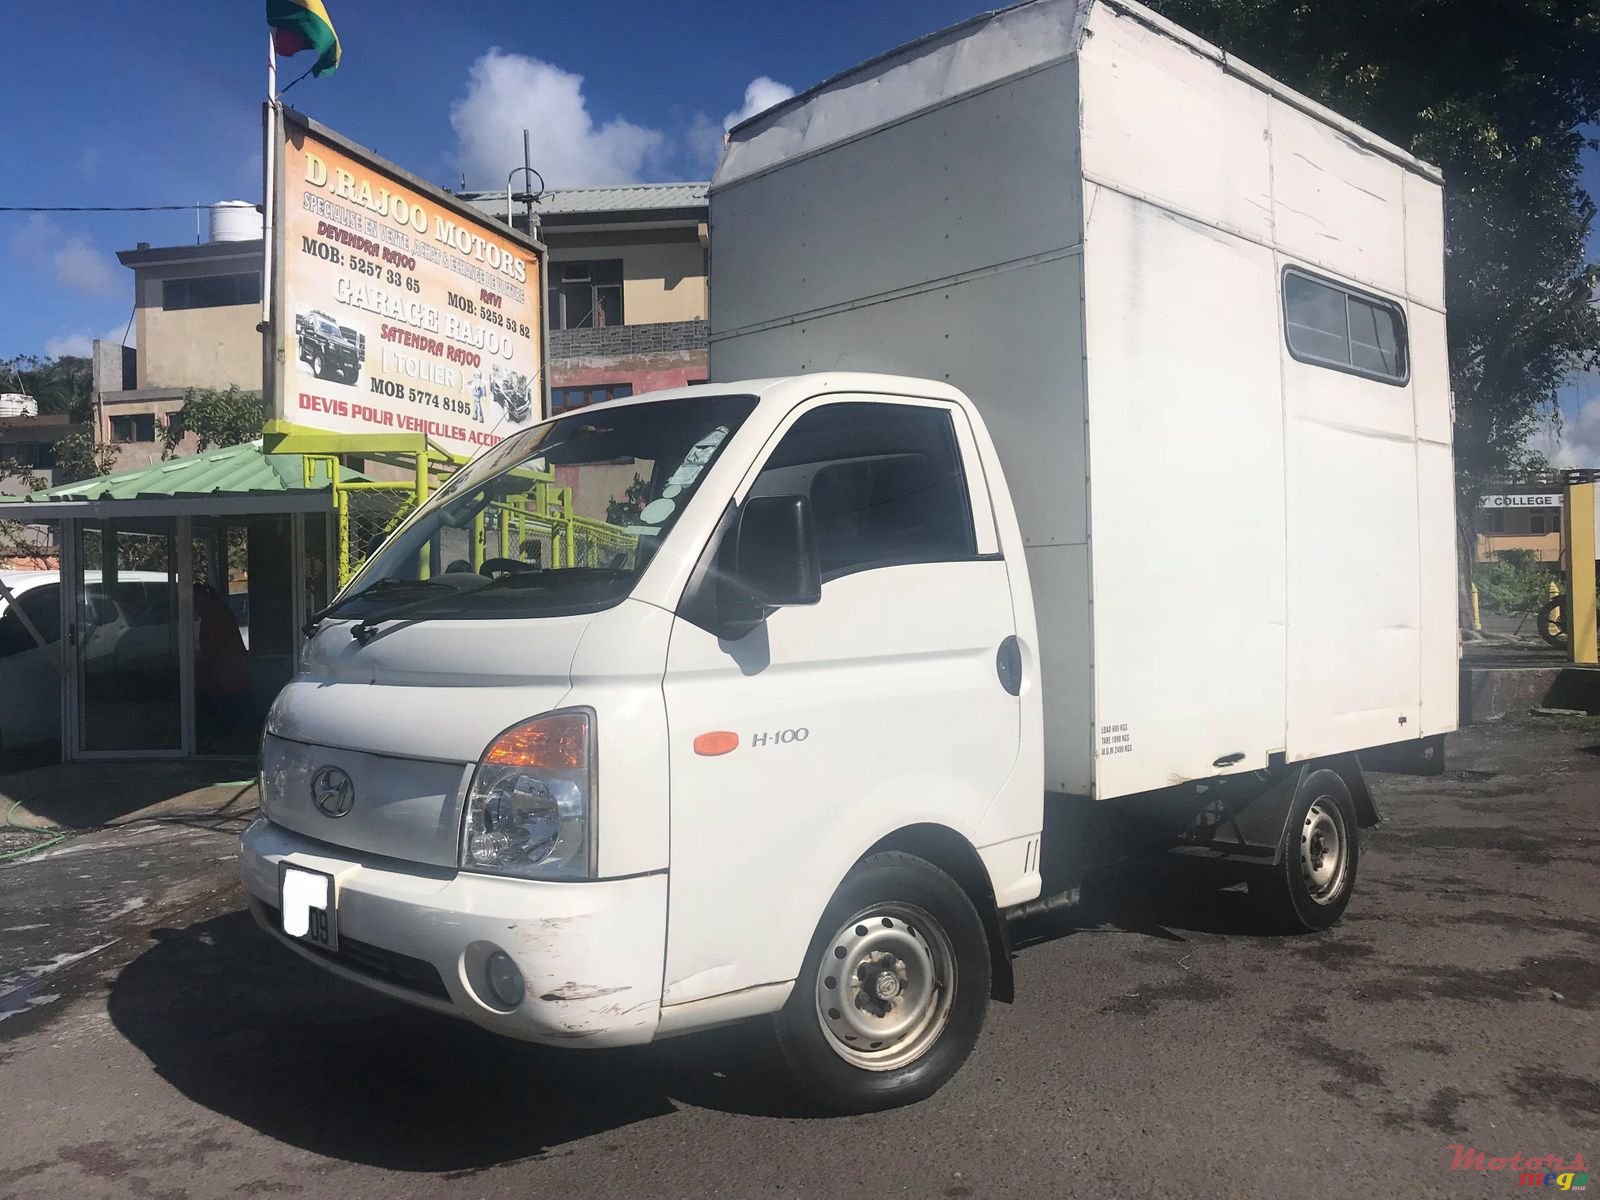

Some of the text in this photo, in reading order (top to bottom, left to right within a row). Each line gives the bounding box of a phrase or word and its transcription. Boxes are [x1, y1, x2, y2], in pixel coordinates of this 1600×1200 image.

[303, 191, 361, 232] SPECIALISE
[364, 216, 377, 238] EN
[379, 223, 409, 251] VENTE
[450, 255, 484, 285] ECHANGE
[304, 151, 526, 284] D.RAJOO MOTORS
[302, 236, 420, 293] MOB: 5257 33 65
[317, 221, 416, 271] DEVENDRA RAJOO
[335, 278, 514, 360] GARAGE RAJOO
[447, 291, 530, 339] MOB: 5252 53 82
[480, 288, 502, 309] RAVI
[380, 323, 481, 368] SATENDRA RAJOO
[298, 393, 505, 447] DEVIS POUR VEHICULES ACCID
[370, 376, 471, 416] MOB 5774 8195
[1494, 496, 1552, 506] COLLEGE
[752, 728, 809, 747] H-100
